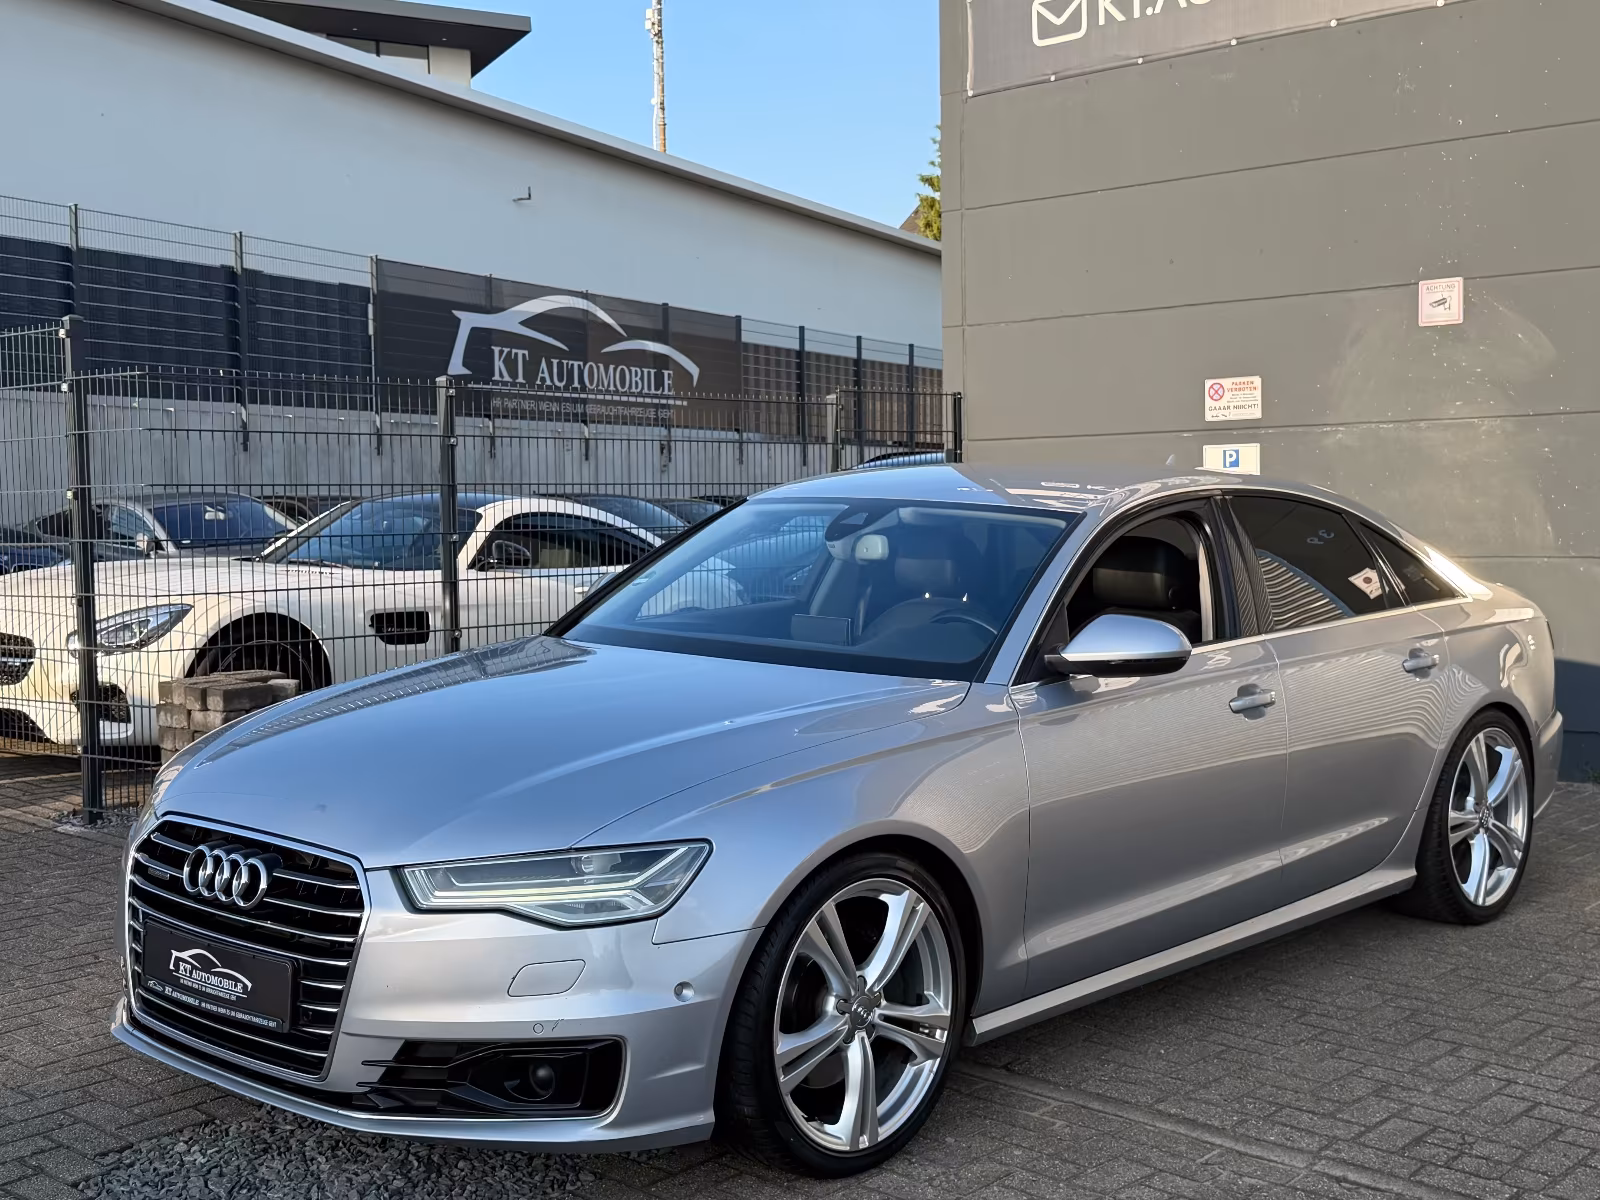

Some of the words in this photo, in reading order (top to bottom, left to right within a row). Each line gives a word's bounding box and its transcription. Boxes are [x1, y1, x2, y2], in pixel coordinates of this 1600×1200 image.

[1426, 283, 1456, 291] ACHTUNG
[491, 346, 529, 383] KT
[535, 357, 674, 395] AUTOMOBILE
[562, 402, 571, 412] ES
[1226, 450, 1236, 468] P
[179, 962, 192, 976] KT
[192, 971, 243, 992] AUTOMOBILE
